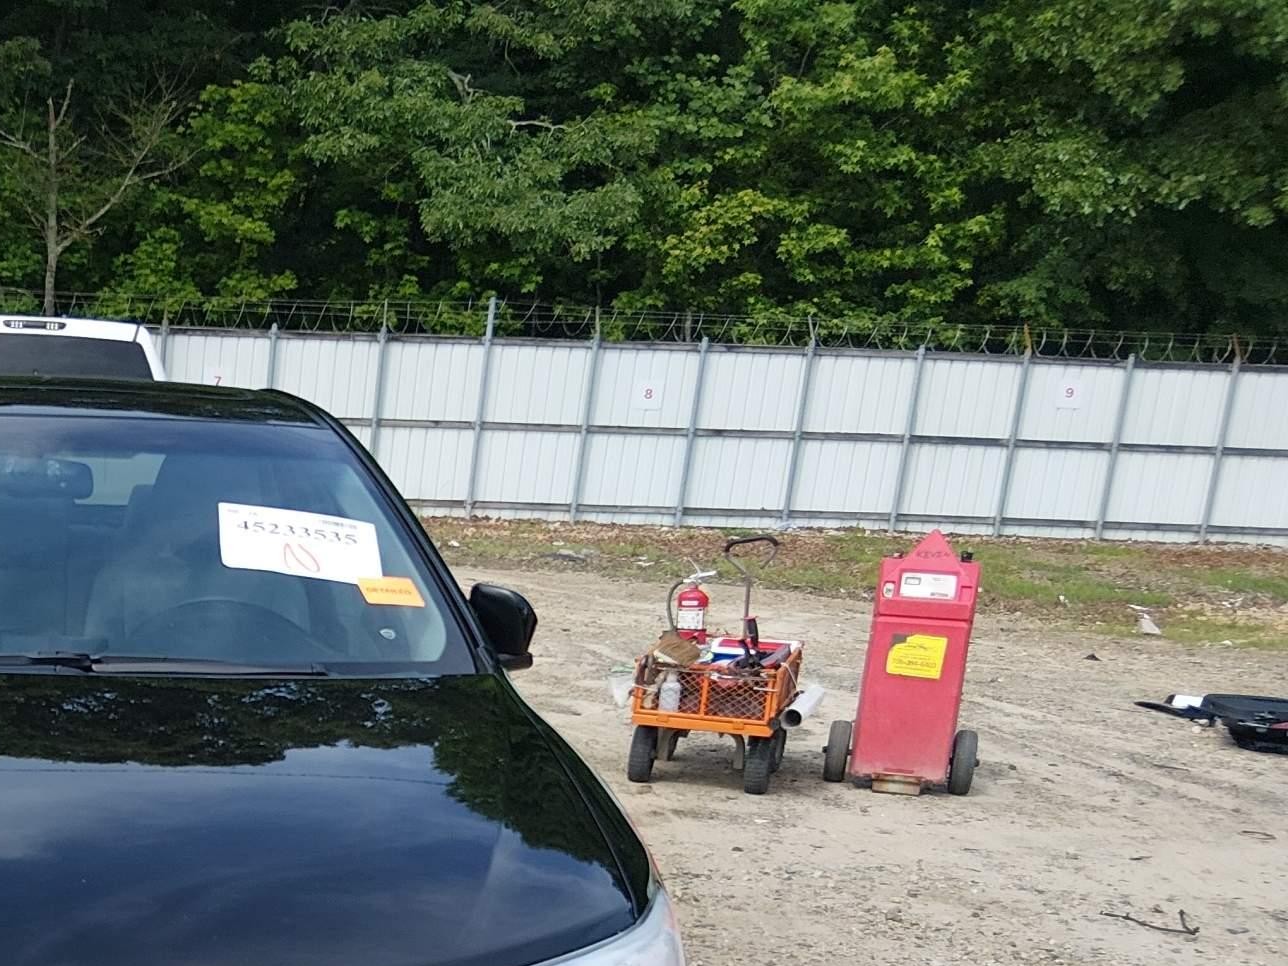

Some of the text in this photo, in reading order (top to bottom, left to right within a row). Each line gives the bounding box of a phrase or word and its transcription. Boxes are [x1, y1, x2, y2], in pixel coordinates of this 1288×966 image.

[214, 376, 222, 386] 7
[644, 388, 653, 399] 8
[1065, 387, 1074, 398] 9
[237, 520, 358, 545] 45233535
